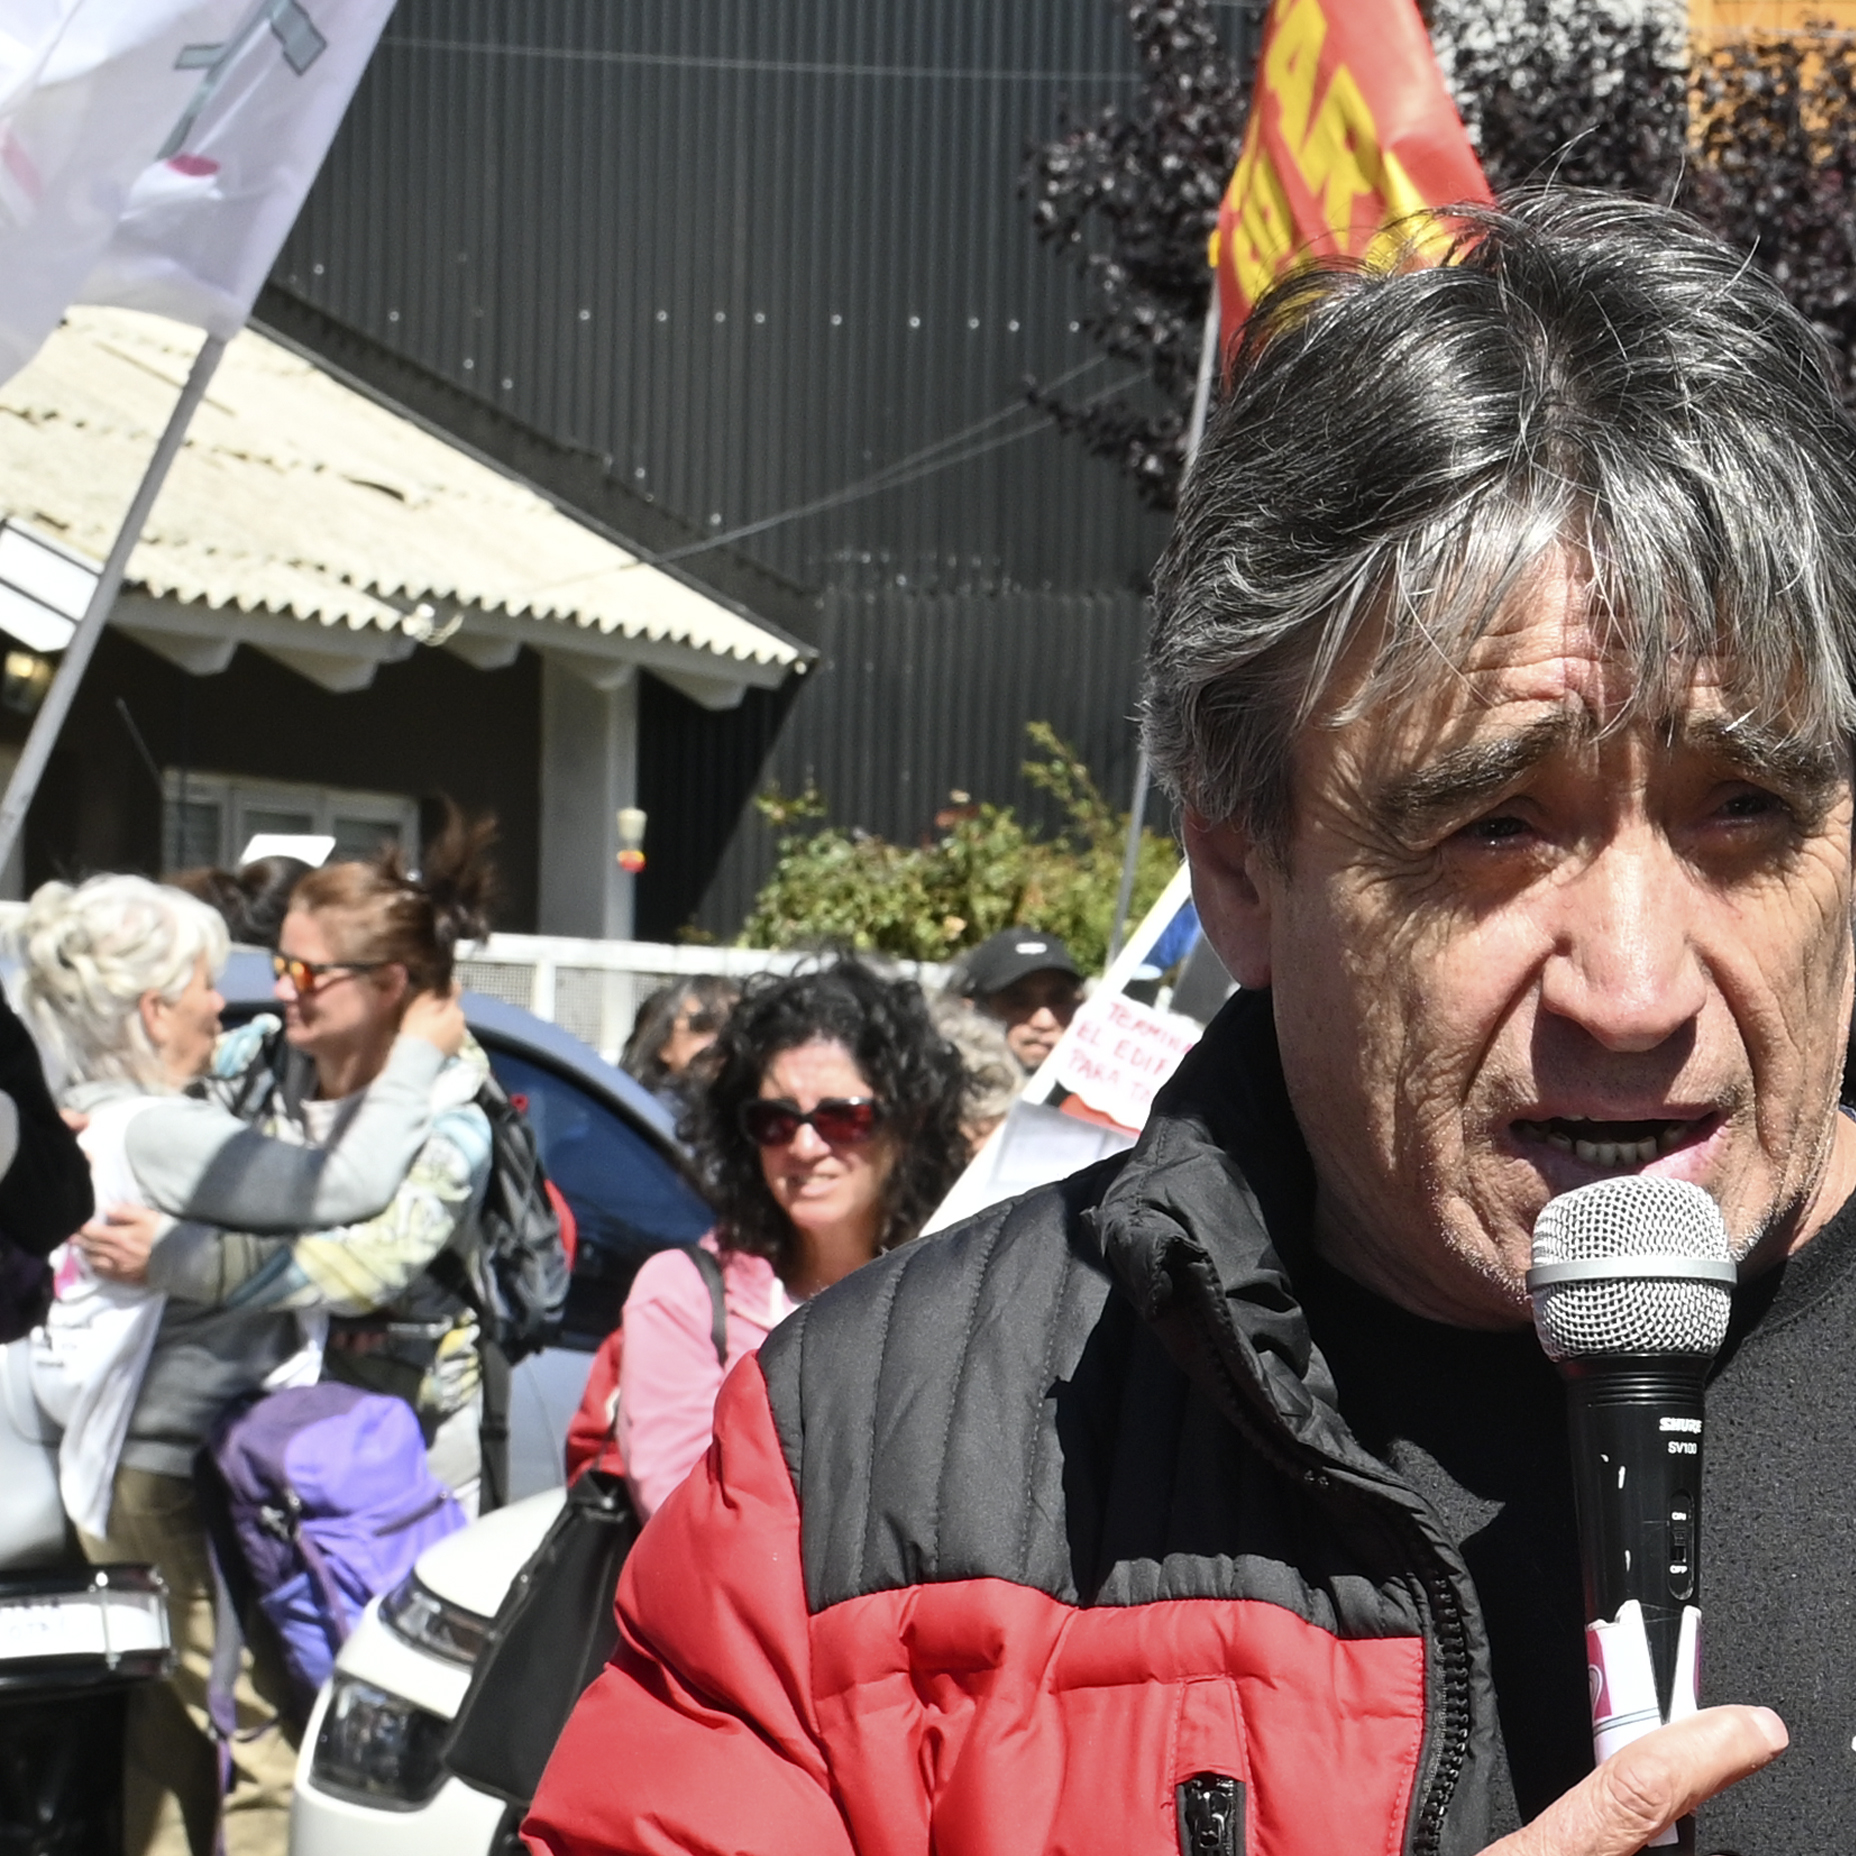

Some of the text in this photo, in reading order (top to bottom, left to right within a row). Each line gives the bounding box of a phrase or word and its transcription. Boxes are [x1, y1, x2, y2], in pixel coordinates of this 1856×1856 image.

[1659, 1417, 1702, 1434] SHURE
[1667, 1441, 1697, 1454] SV100
[1671, 1511, 1687, 1521] ON
[1669, 1564, 1687, 1575] OFF
